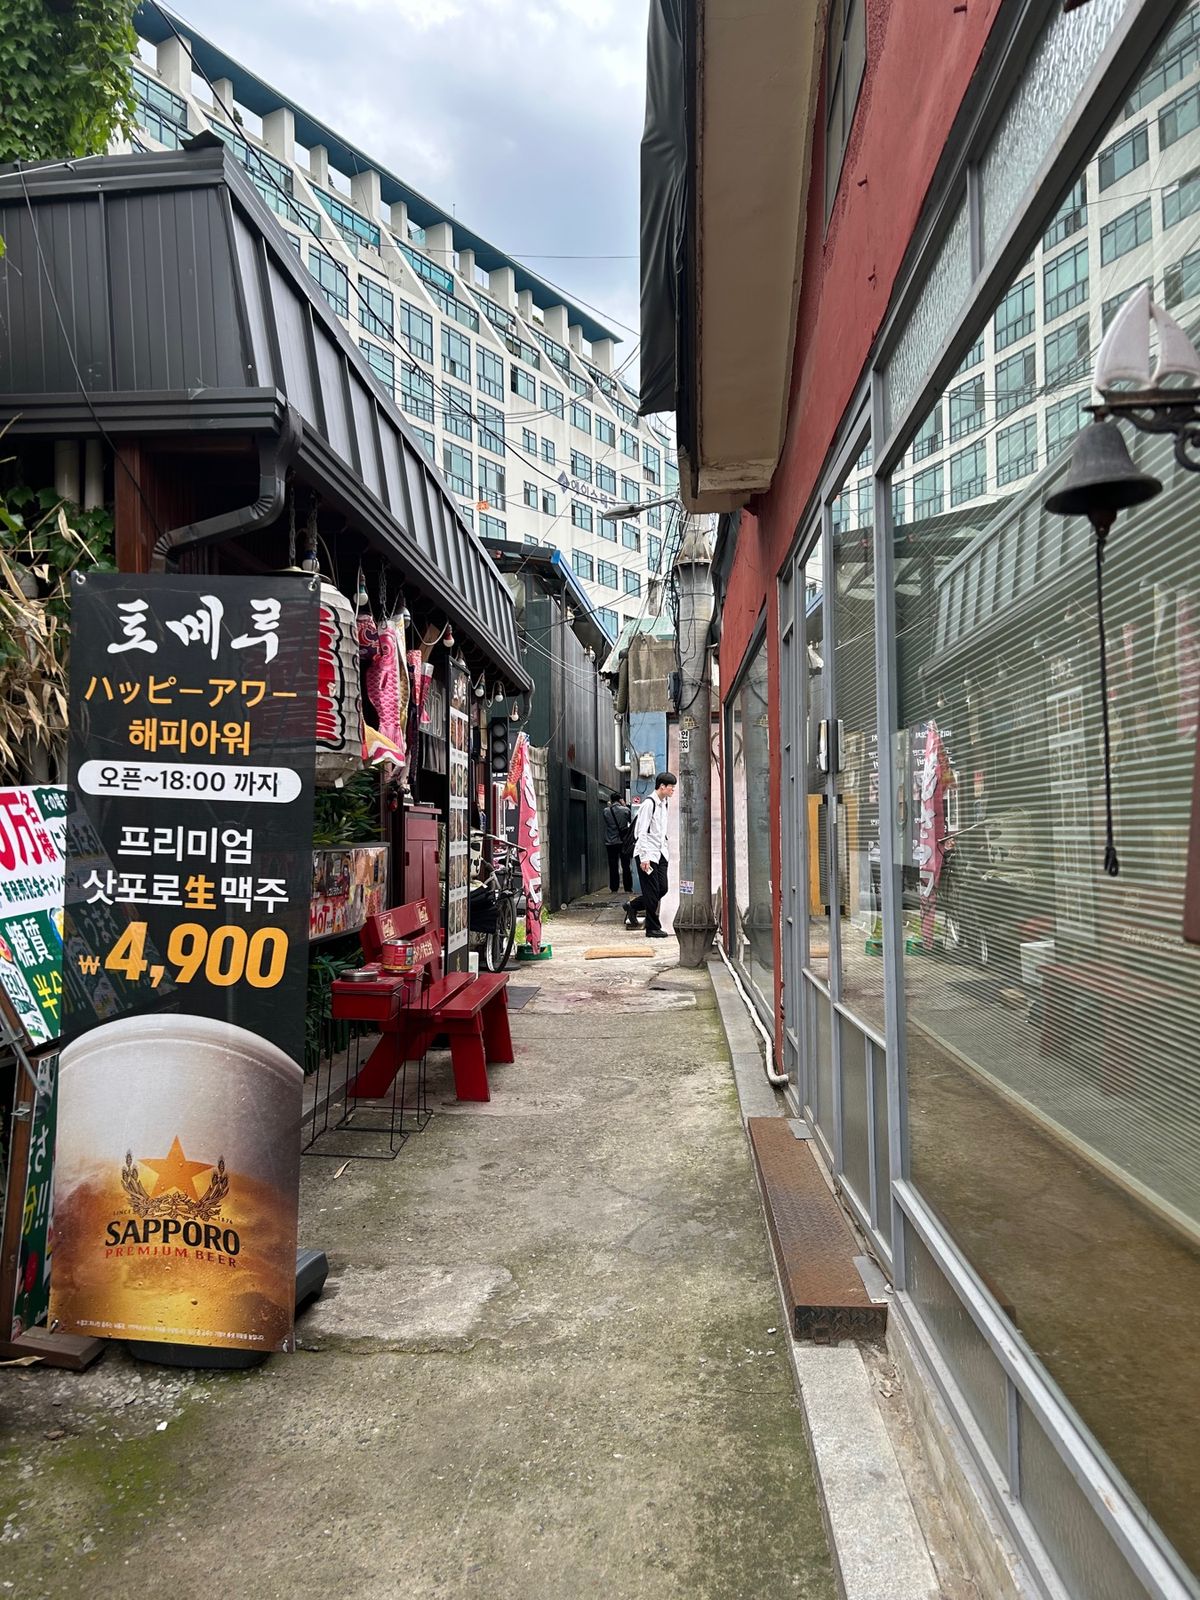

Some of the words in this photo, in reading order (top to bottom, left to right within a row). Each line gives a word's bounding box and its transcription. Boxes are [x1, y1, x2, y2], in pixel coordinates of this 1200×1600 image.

[107, 595, 281, 664] 토메루
[85, 676, 297, 708] ハッピーアワー
[128, 718, 251, 756] 해피아워
[98, 766, 226, 793] 오픈~18:00
[233, 770, 279, 798] 까지
[117, 826, 253, 864] 프리미엄
[105, 1219, 240, 1256] SAPPORO
[105, 1246, 188, 1259] PREMIUM
[195, 1250, 237, 1268] BEER
